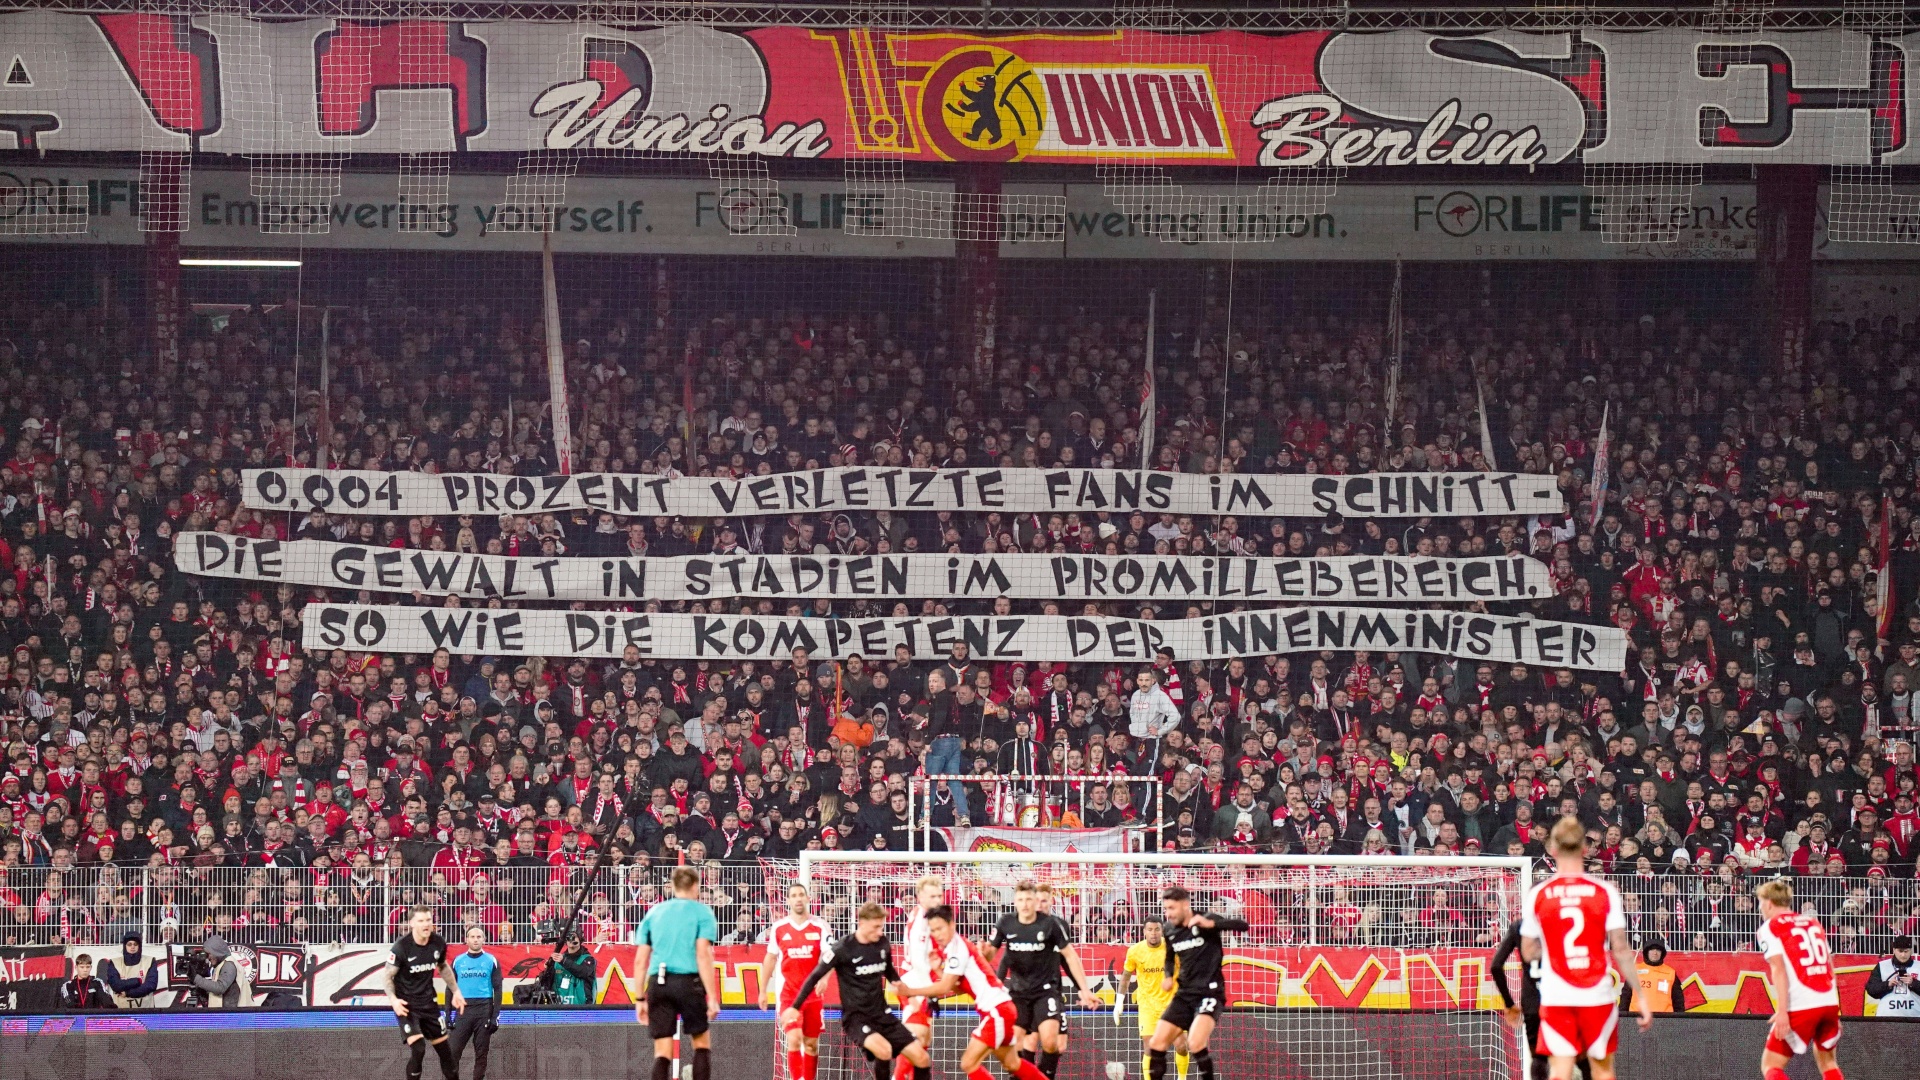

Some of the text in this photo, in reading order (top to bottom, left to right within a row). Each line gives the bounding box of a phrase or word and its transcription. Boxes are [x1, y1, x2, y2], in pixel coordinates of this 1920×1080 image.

[530, 79, 833, 158] Union
[1045, 73, 1224, 148] UNION
[1251, 91, 1547, 166] Berlin
[202, 193, 653, 237] Empowering yourself.
[1220, 205, 1348, 238] Union.
[757, 242, 832, 253] BERLIN
[1475, 245, 1551, 256] BERLIN
[256, 470, 402, 511] 0,004
[442, 475, 671, 514] PROZENT
[710, 469, 1004, 514] VERLETZTE
[1045, 469, 1173, 508] FANS
[332, 546, 559, 598] GEWALT
[320, 607, 387, 647] SO
[694, 617, 1026, 657] KOMPETENZ
[1066, 619, 1164, 659] DER
[1560, 907, 1589, 957] 2
[1790, 925, 1828, 967] 36
[260, 952, 298, 981] DK
[461, 971, 487, 979] JOBRAD
[126, 999, 143, 1008] TV
[1889, 1000, 1914, 1010] SMF
